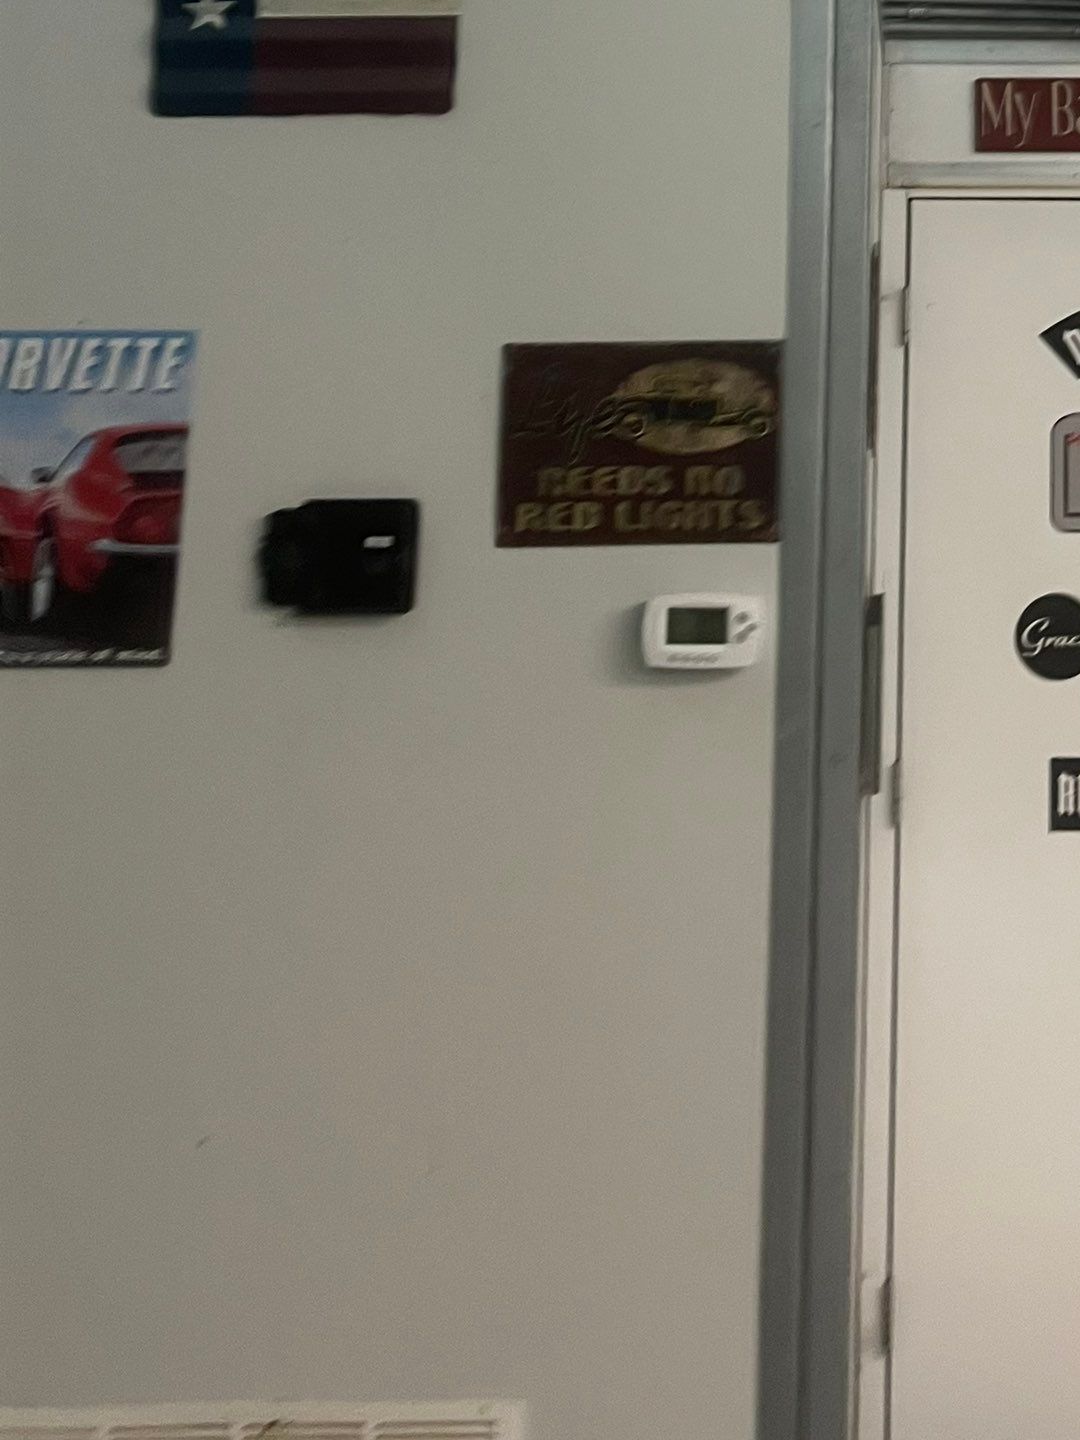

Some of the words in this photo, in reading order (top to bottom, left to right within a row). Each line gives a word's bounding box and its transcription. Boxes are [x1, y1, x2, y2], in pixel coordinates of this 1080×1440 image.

[980, 81, 1037, 148] My
[537, 465, 674, 497] NEEDS
[683, 464, 745, 496] NO
[513, 501, 602, 533] RED
[613, 499, 769, 532] LIGHTS
